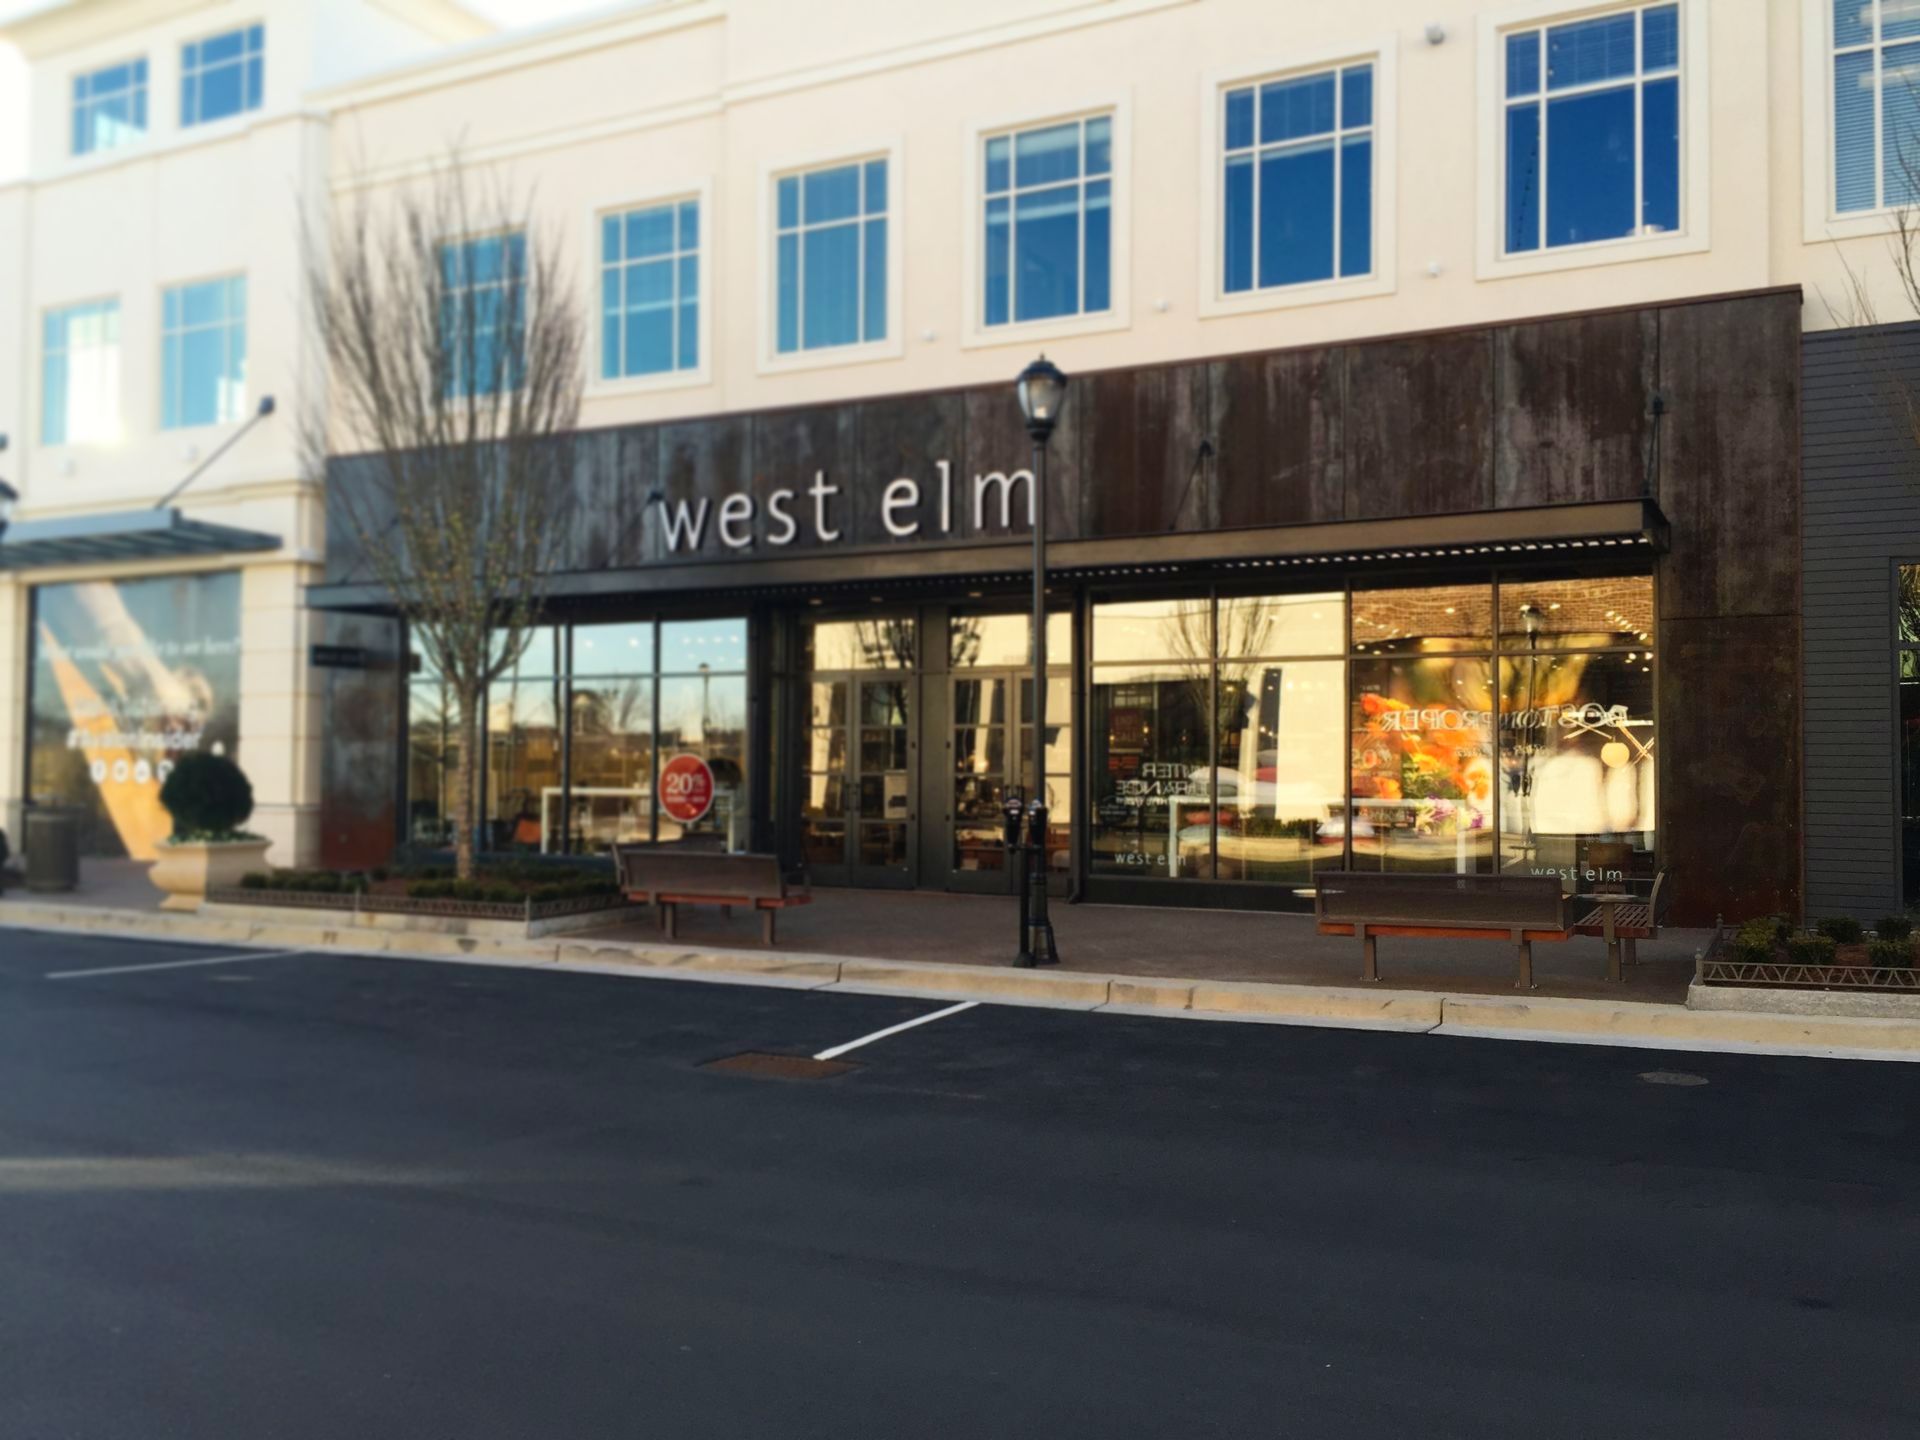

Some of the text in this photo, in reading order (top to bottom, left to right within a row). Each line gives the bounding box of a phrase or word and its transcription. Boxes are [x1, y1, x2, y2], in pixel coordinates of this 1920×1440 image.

[659, 459, 1035, 552] west elm
[1114, 852, 1152, 866] west
[1530, 867, 1623, 882] west elm
